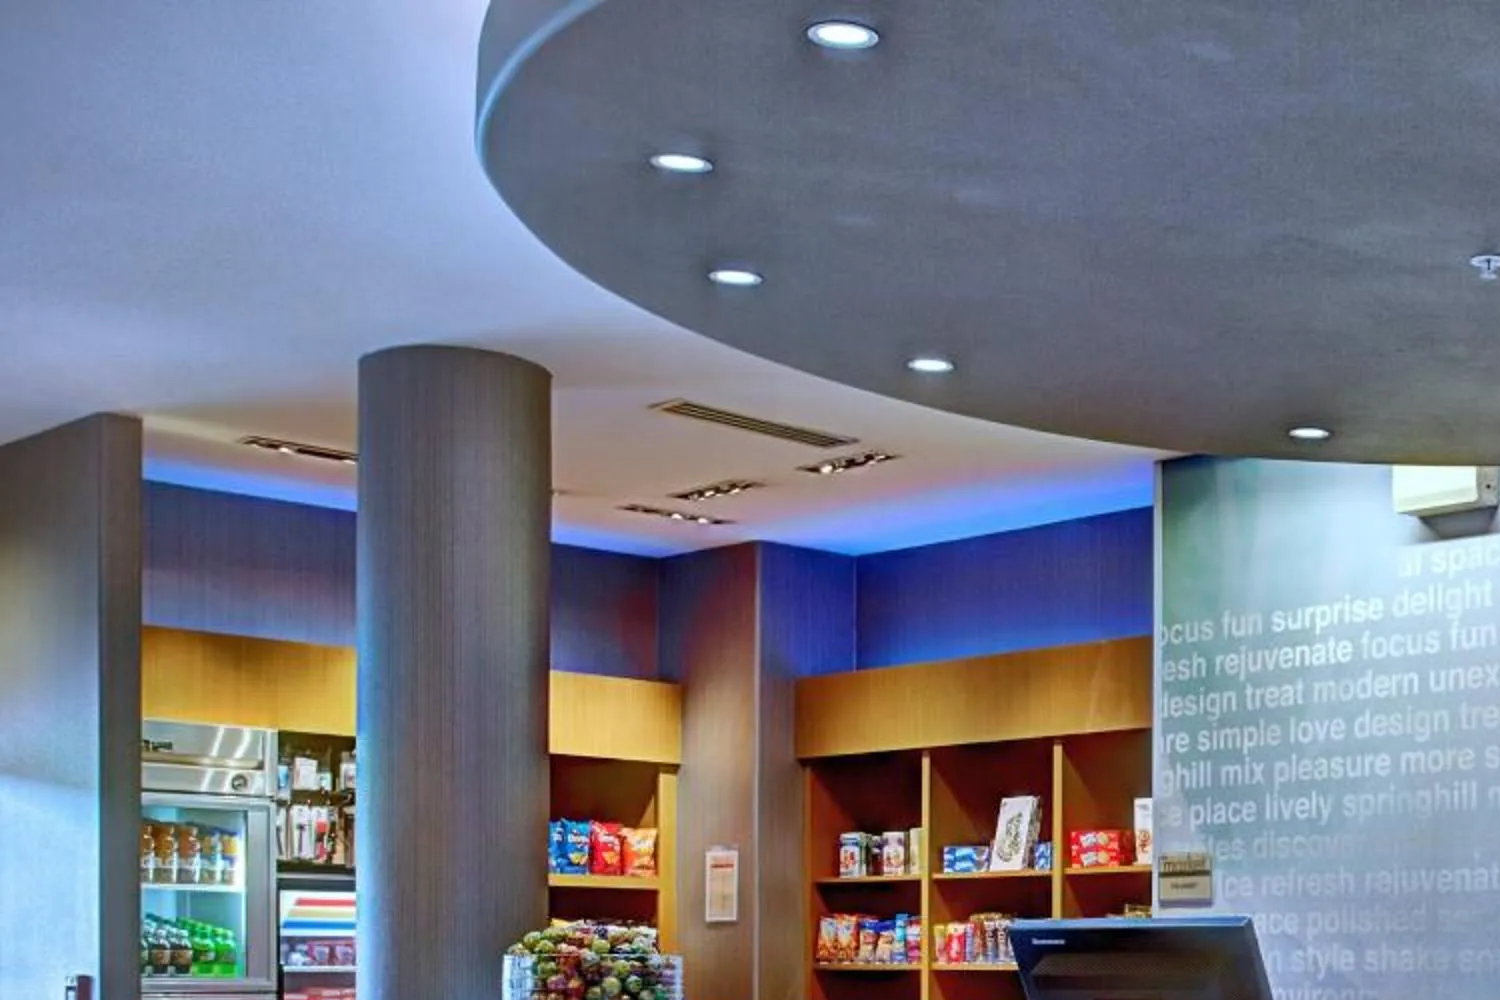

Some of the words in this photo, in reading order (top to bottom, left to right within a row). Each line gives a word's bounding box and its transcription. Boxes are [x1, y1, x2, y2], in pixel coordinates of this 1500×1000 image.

[1221, 609, 1263, 639] fun
[1270, 593, 1384, 635] surprise
[1391, 579, 1494, 620] delight
[1214, 636, 1353, 681] rejuvenate
[1360, 629, 1441, 660] focus
[1449, 620, 1497, 650] fun
[1246, 679, 1305, 711] treat
[1312, 669, 1420, 704] modern
[1160, 732, 1190, 754] re
[1197, 721, 1281, 755] simple
[1289, 715, 1346, 744] love
[1353, 706, 1450, 743] design
[1220, 755, 1265, 786] mix
[1273, 752, 1392, 787] pleasure
[1400, 747, 1476, 775] more
[1189, 798, 1257, 831] place
[1265, 790, 1333, 825] lively
[1342, 778, 1479, 824] springhill
[1260, 863, 1354, 896] refresh
[1290, 943, 1357, 980] style
[1362, 941, 1450, 973] shake
